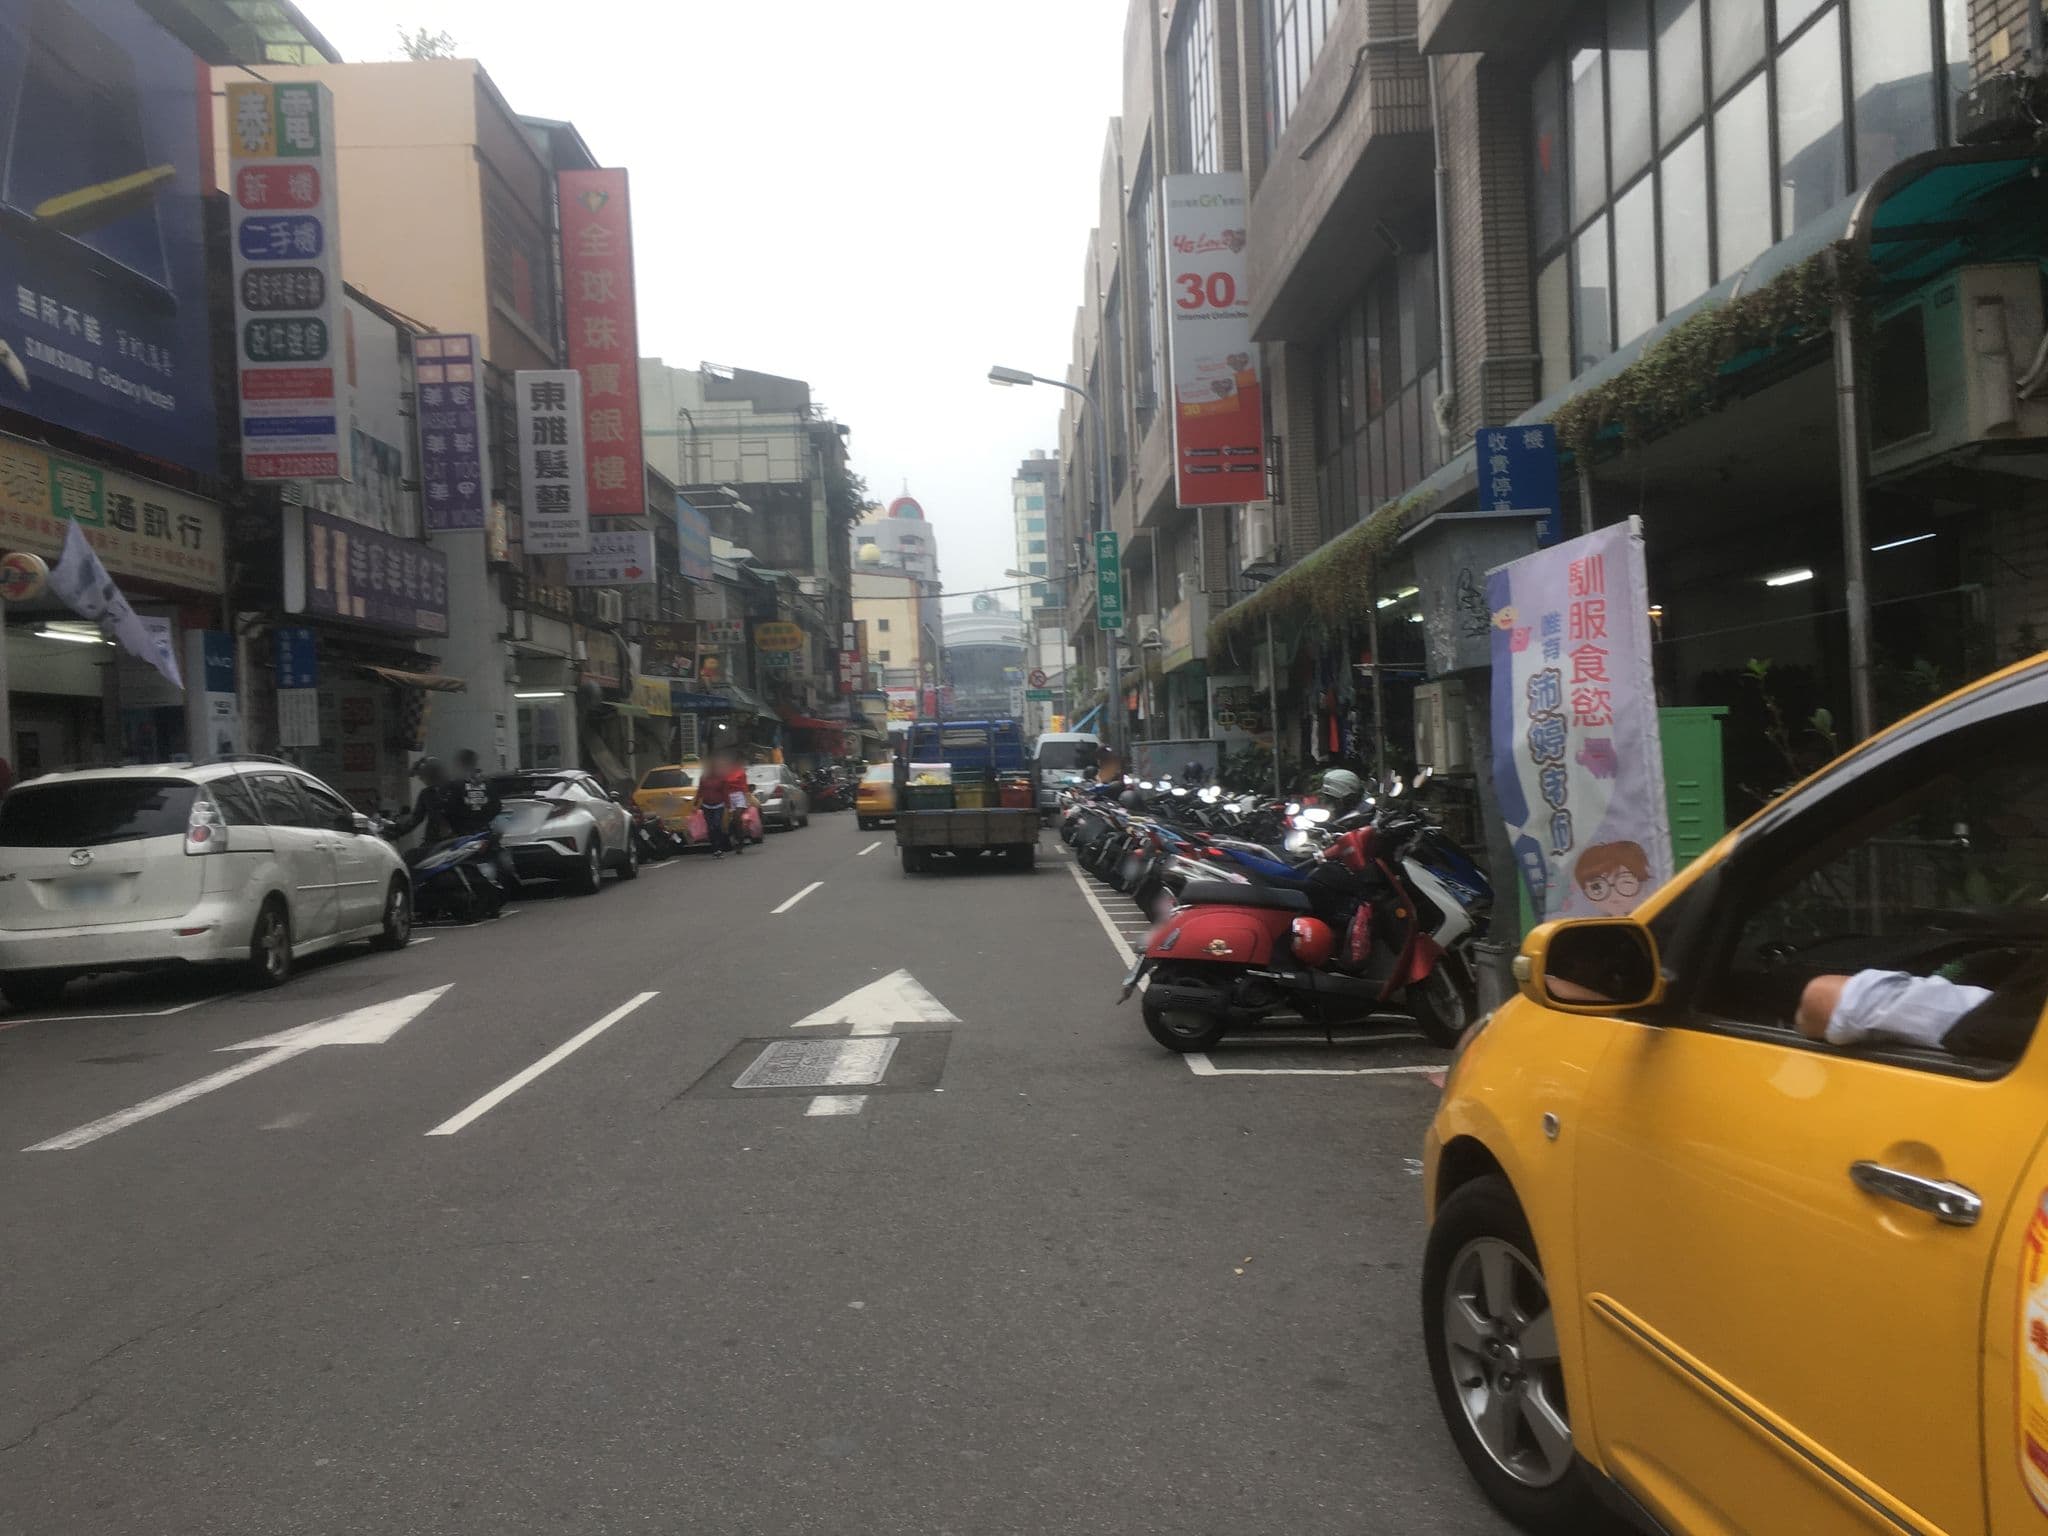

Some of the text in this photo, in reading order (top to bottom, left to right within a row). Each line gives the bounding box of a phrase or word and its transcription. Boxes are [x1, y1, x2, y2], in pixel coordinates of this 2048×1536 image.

[246, 221, 316, 254] 二手機
[1176, 271, 1236, 309] 30
[25, 336, 95, 381] SAMSUNG
[578, 222, 627, 490] 全球珠寶銀樓
[1568, 554, 1614, 728] 馴服食慾
